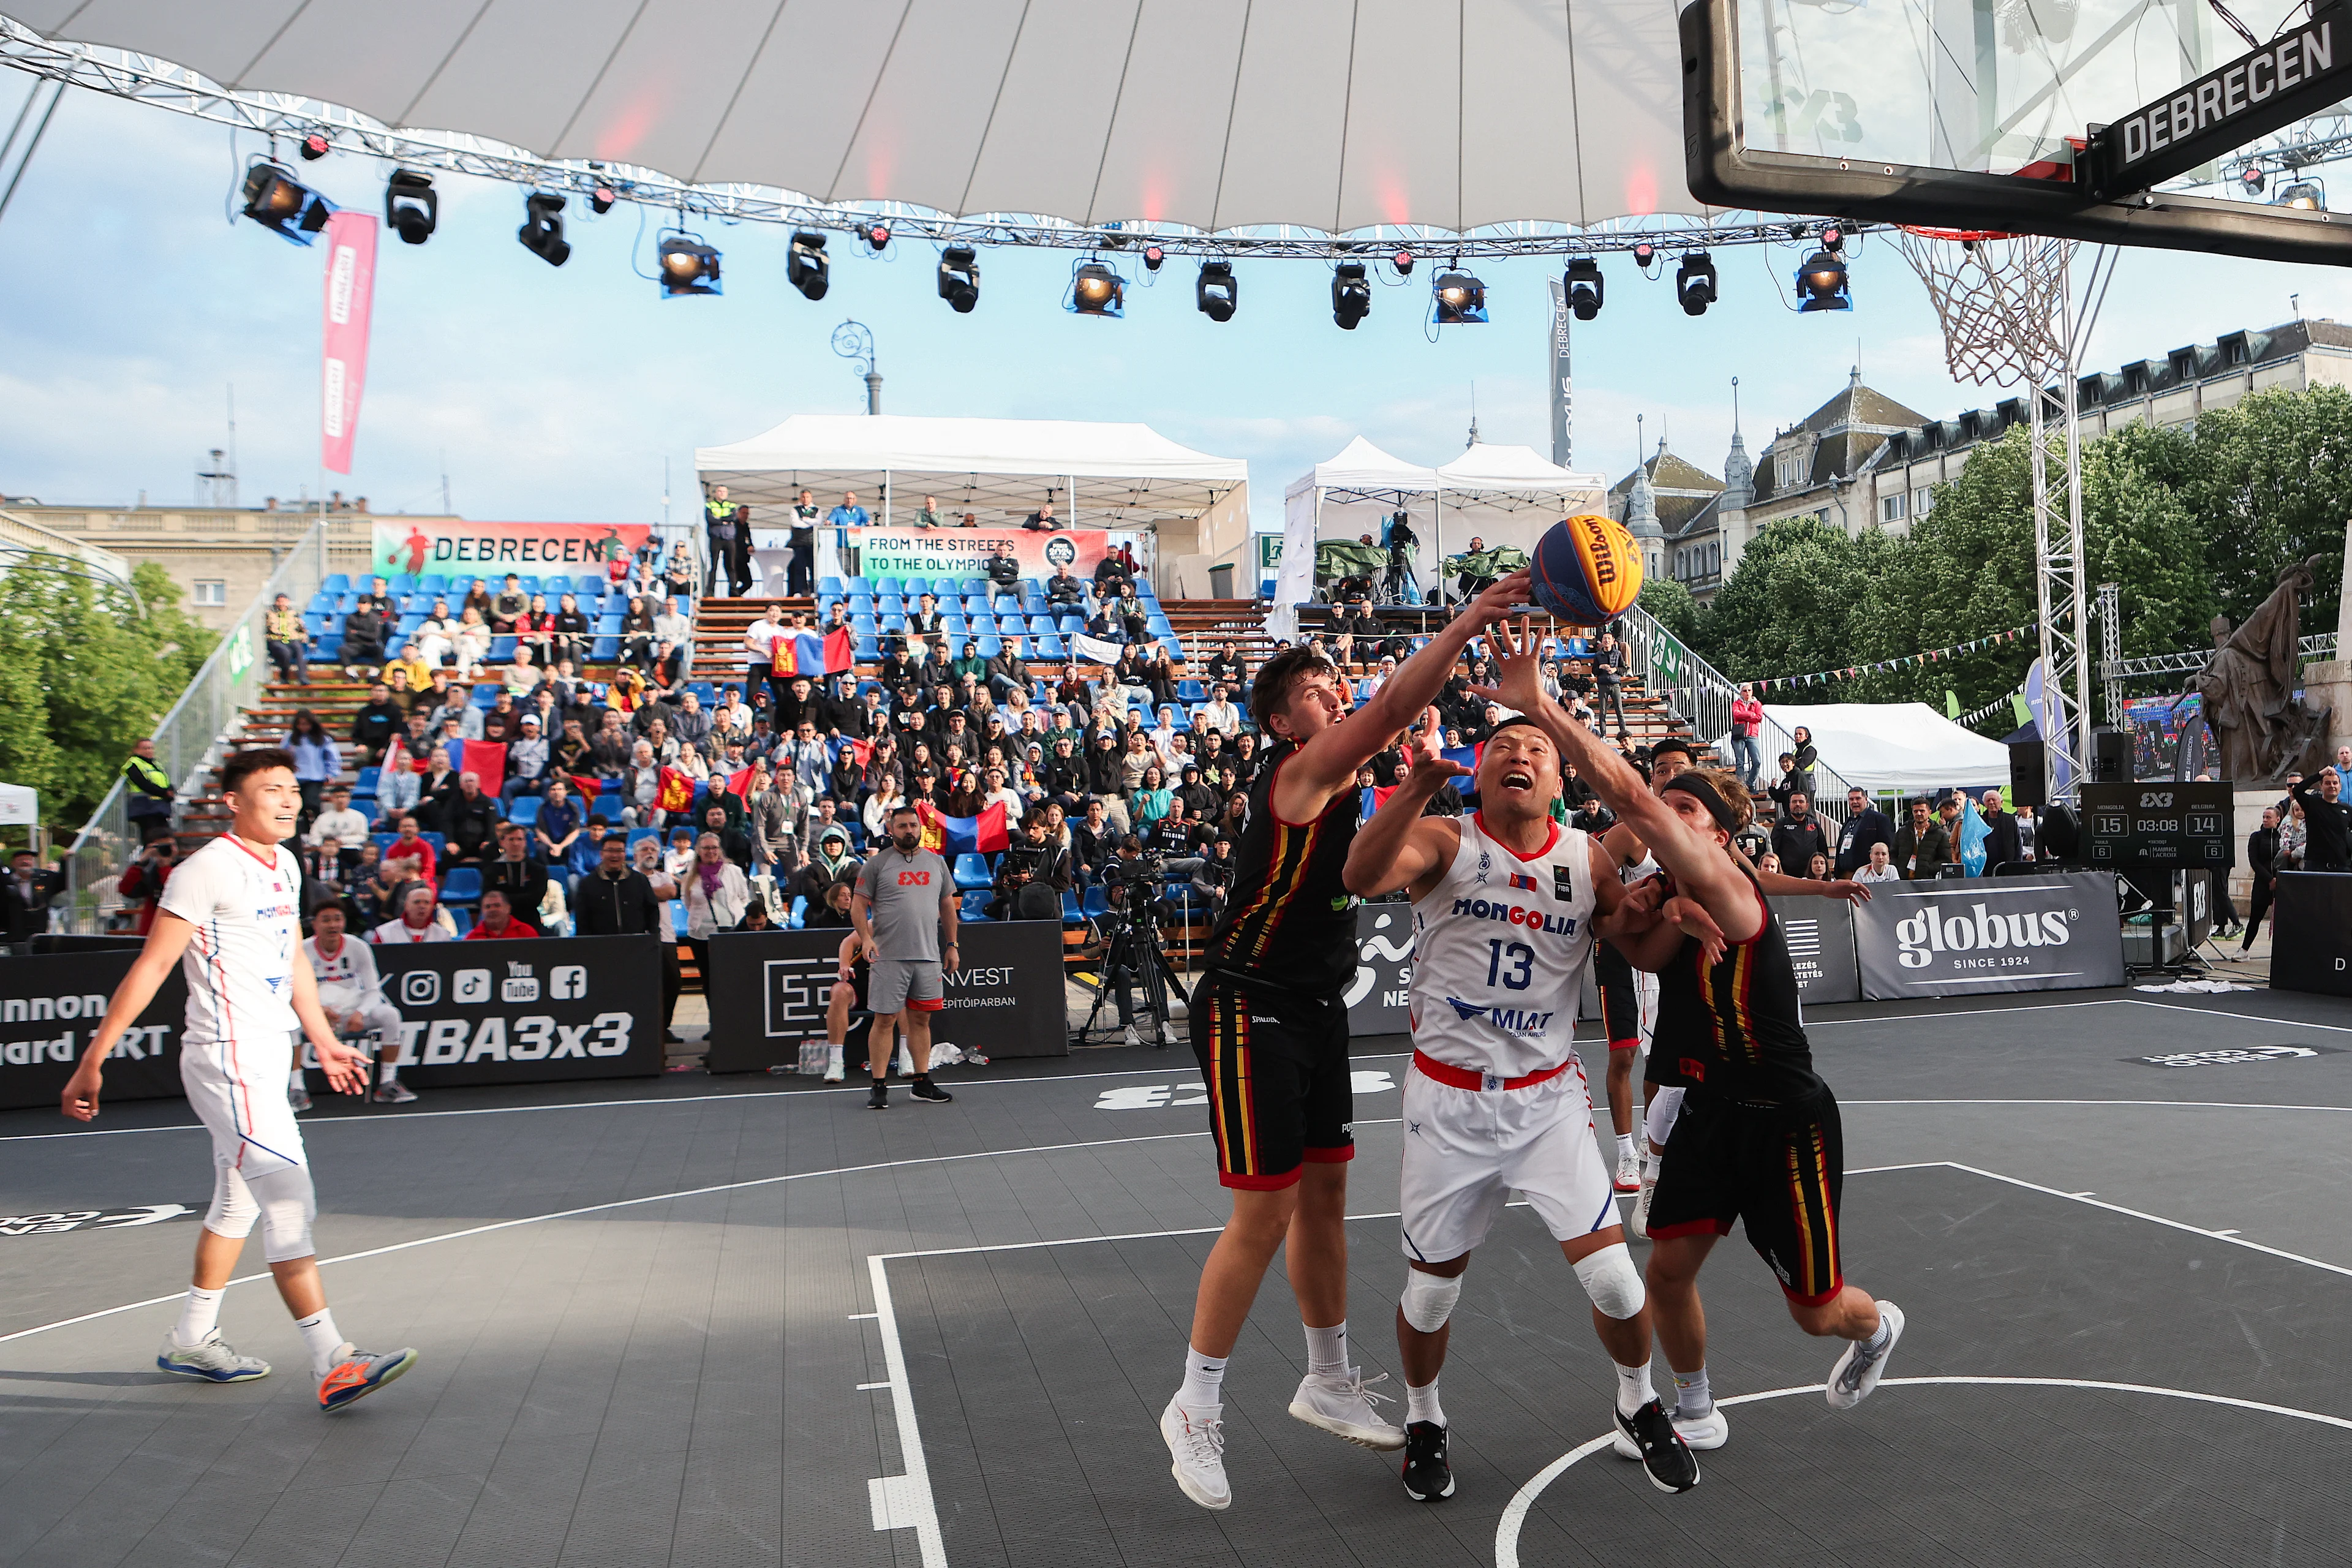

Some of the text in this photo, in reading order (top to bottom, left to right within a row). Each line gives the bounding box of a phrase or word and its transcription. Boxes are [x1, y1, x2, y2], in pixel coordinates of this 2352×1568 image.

[2124, 21, 2331, 164] DEBRECEN
[1556, 296, 1570, 358] DEBRECEN
[435, 537, 605, 562] DEBRECEN
[870, 538, 910, 550] FROM
[915, 538, 943, 551] THE
[870, 558, 889, 570] TO
[893, 558, 922, 570] THE
[2100, 818, 2121, 833] 15
[2137, 820, 2178, 832] 03:08
[2193, 817, 2215, 832] 14
[2098, 848, 2106, 857] 6
[2211, 847, 2218, 856] 6
[1558, 884, 1569, 893] FIBA
[1452, 899, 1576, 936] MONGOLIA
[507, 961, 533, 977] You
[1487, 938, 1535, 990] 13
[1954, 956, 2030, 970] SINCE 1924
[506, 981, 535, 998] Tube
[0, 993, 107, 1023] nnon
[1492, 1008, 1554, 1030] MIAT
[0, 1024, 172, 1066] ard RT
